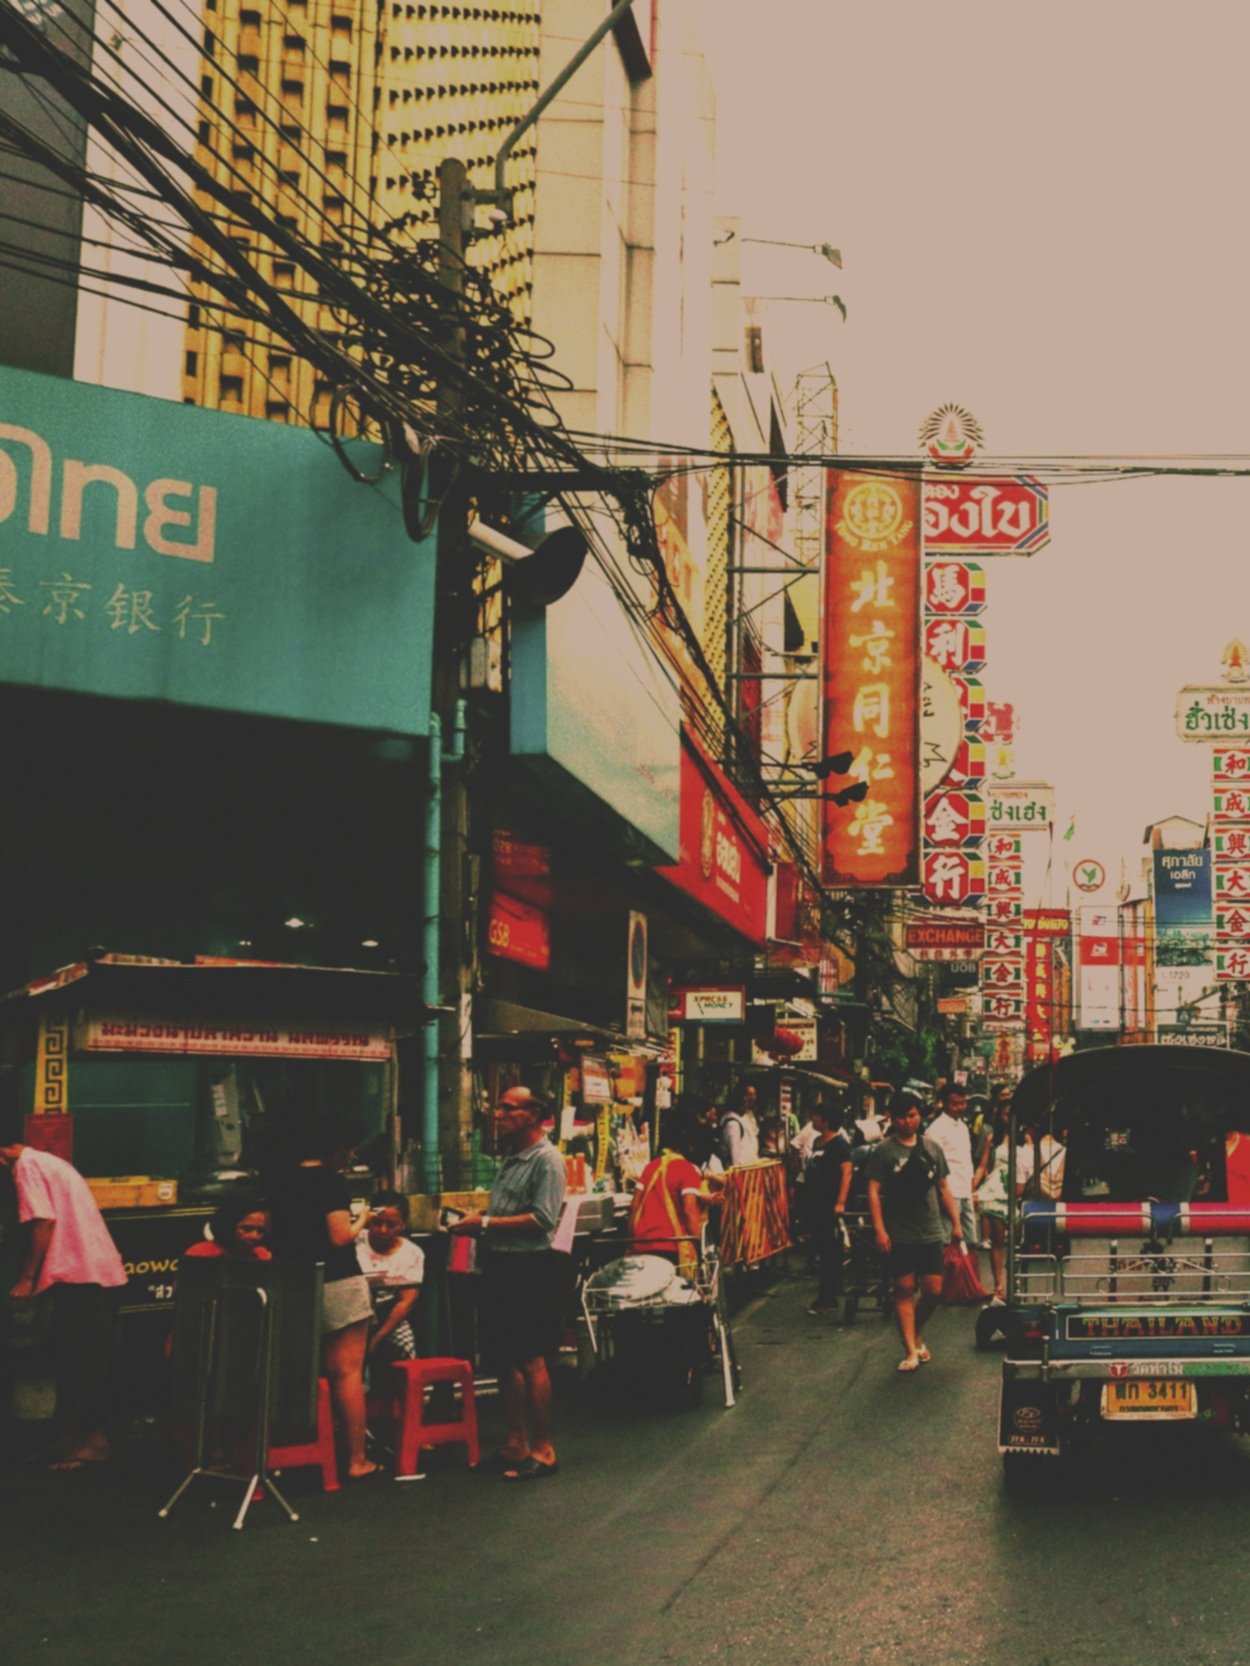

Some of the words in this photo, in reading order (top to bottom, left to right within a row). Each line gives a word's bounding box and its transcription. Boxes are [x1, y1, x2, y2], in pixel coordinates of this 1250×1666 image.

[848, 559, 896, 856] 北京同仁堂
[908, 929, 985, 943] EXCHANGE
[951, 962, 977, 974] UOB
[1082, 1315, 1243, 1337] THAILAND
[1147, 1382, 1188, 1399] 3411
